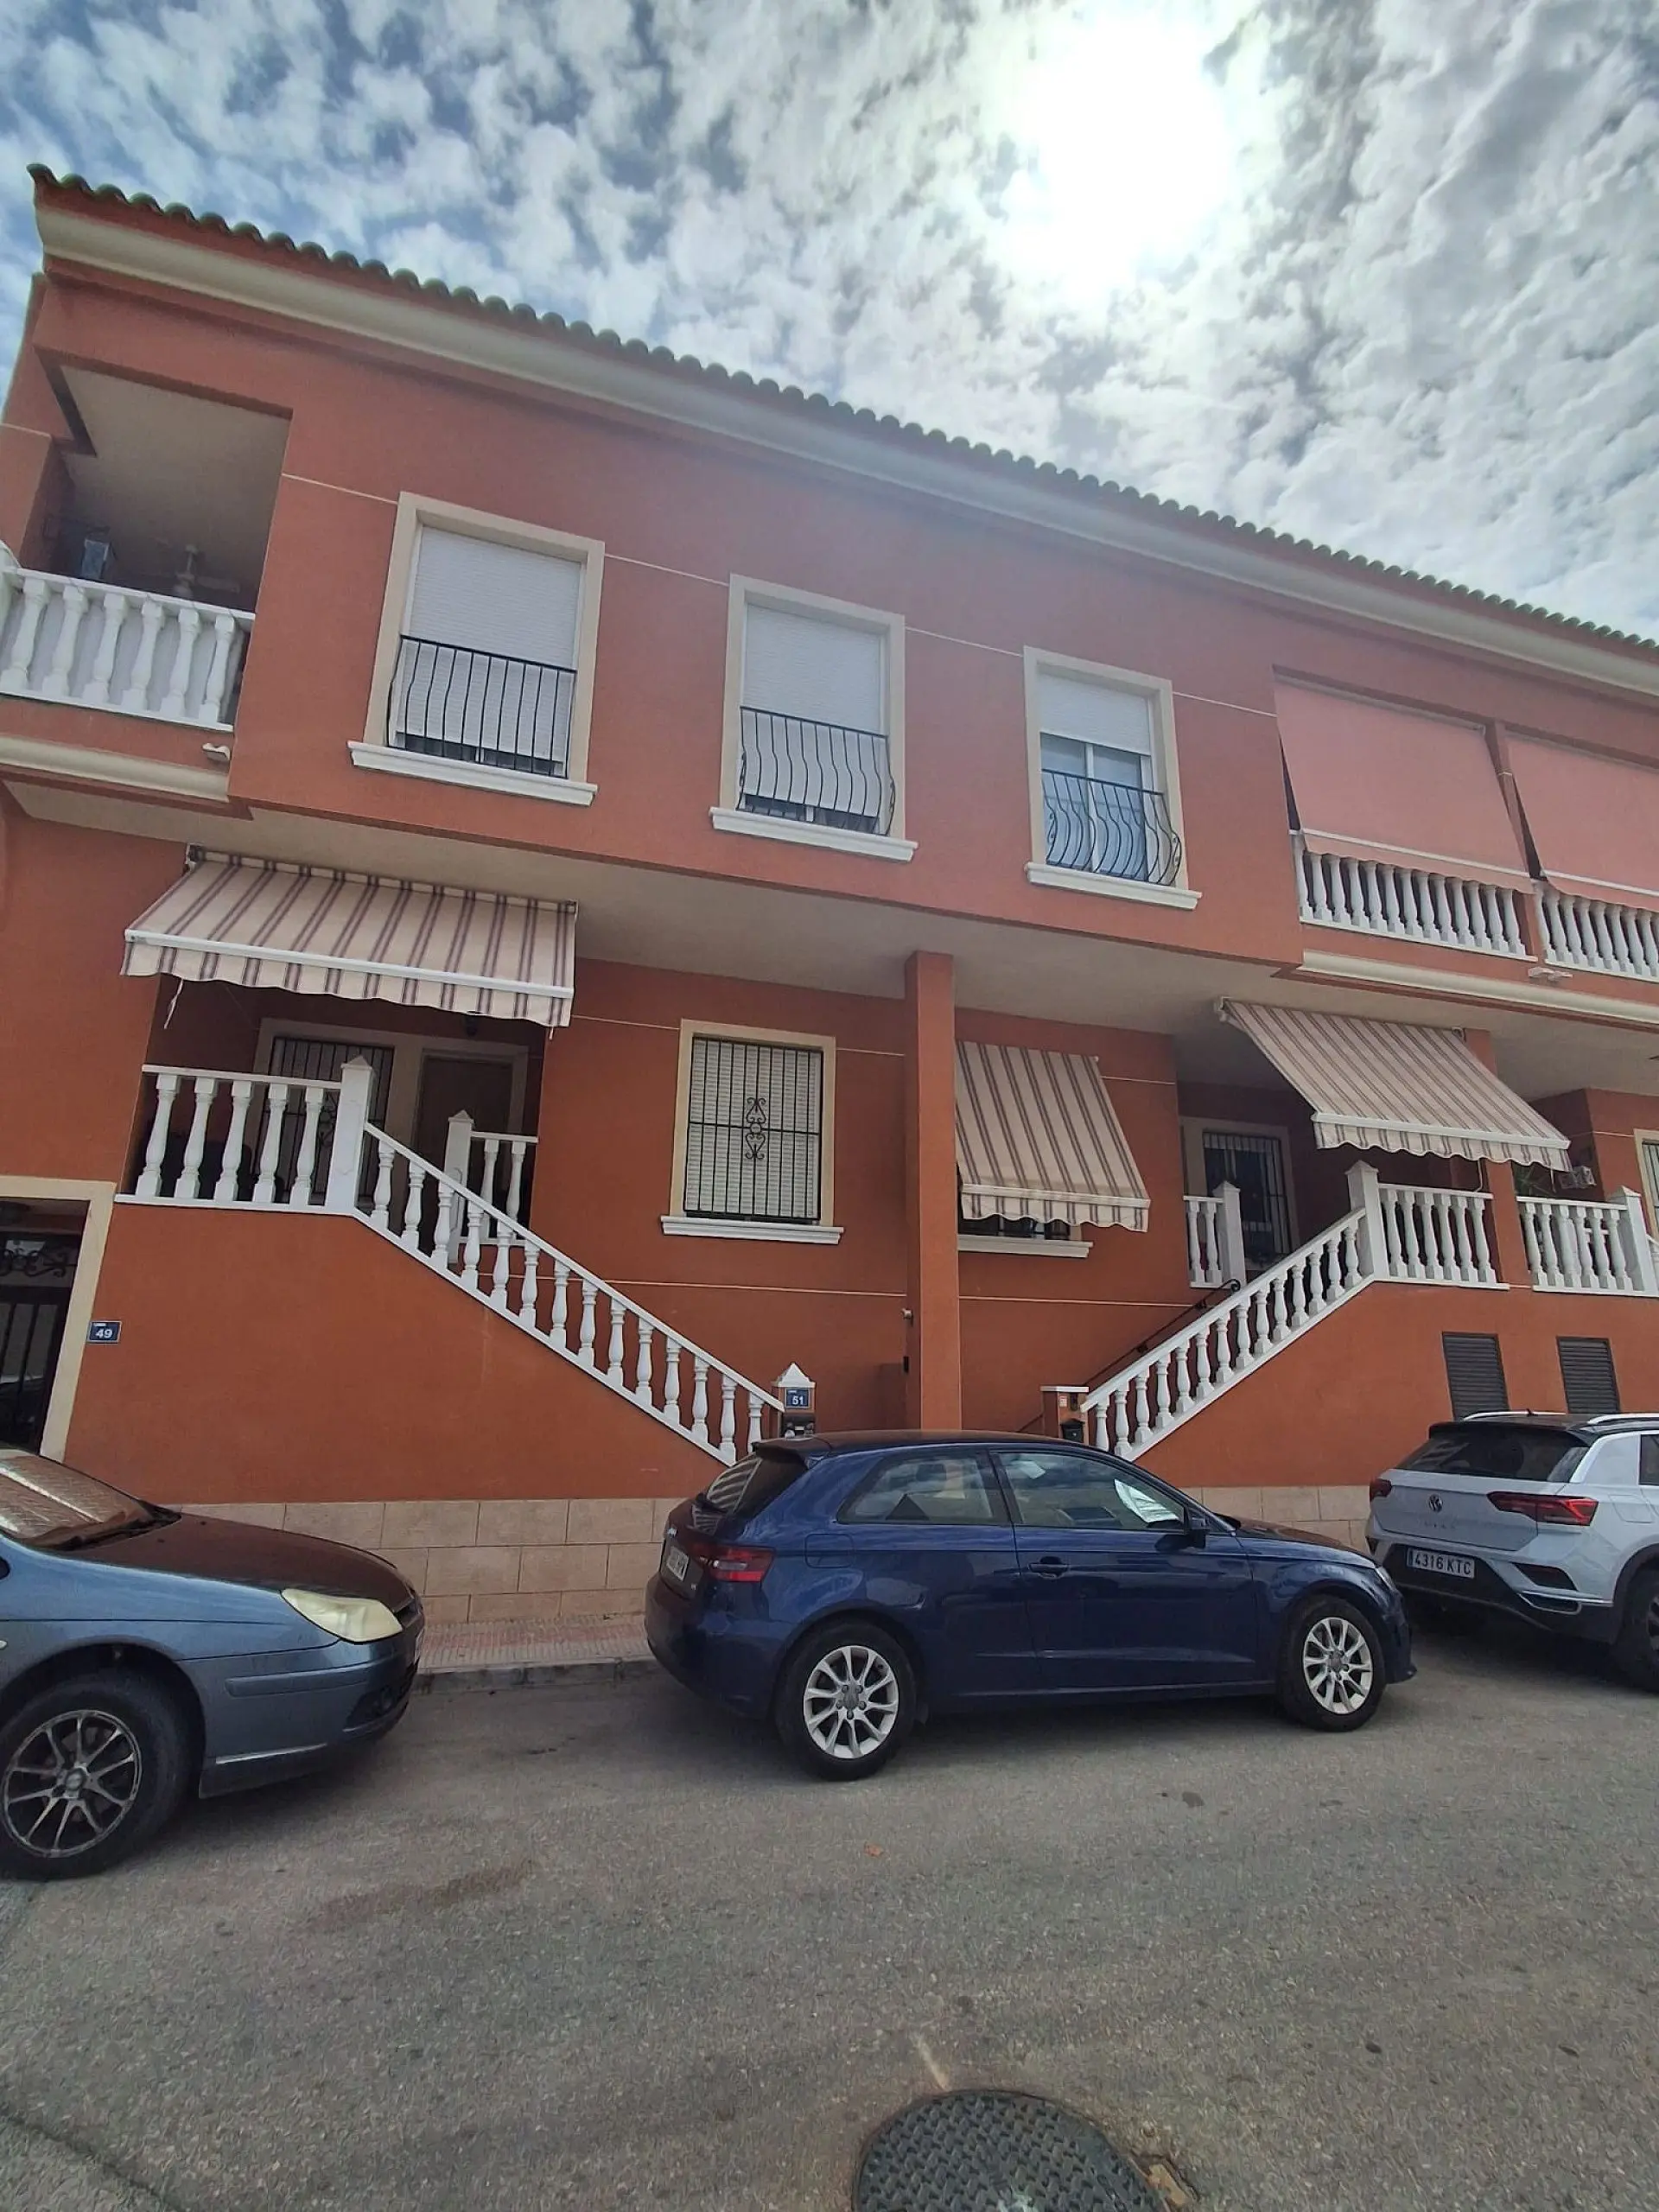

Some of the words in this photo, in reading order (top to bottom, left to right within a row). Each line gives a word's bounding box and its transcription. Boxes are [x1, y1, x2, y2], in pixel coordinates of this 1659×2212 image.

[95, 1328, 113, 1338] 49
[791, 1395, 804, 1405] 51
[1415, 1553, 1444, 1570] 4316
[1446, 1557, 1471, 1574] KTC
